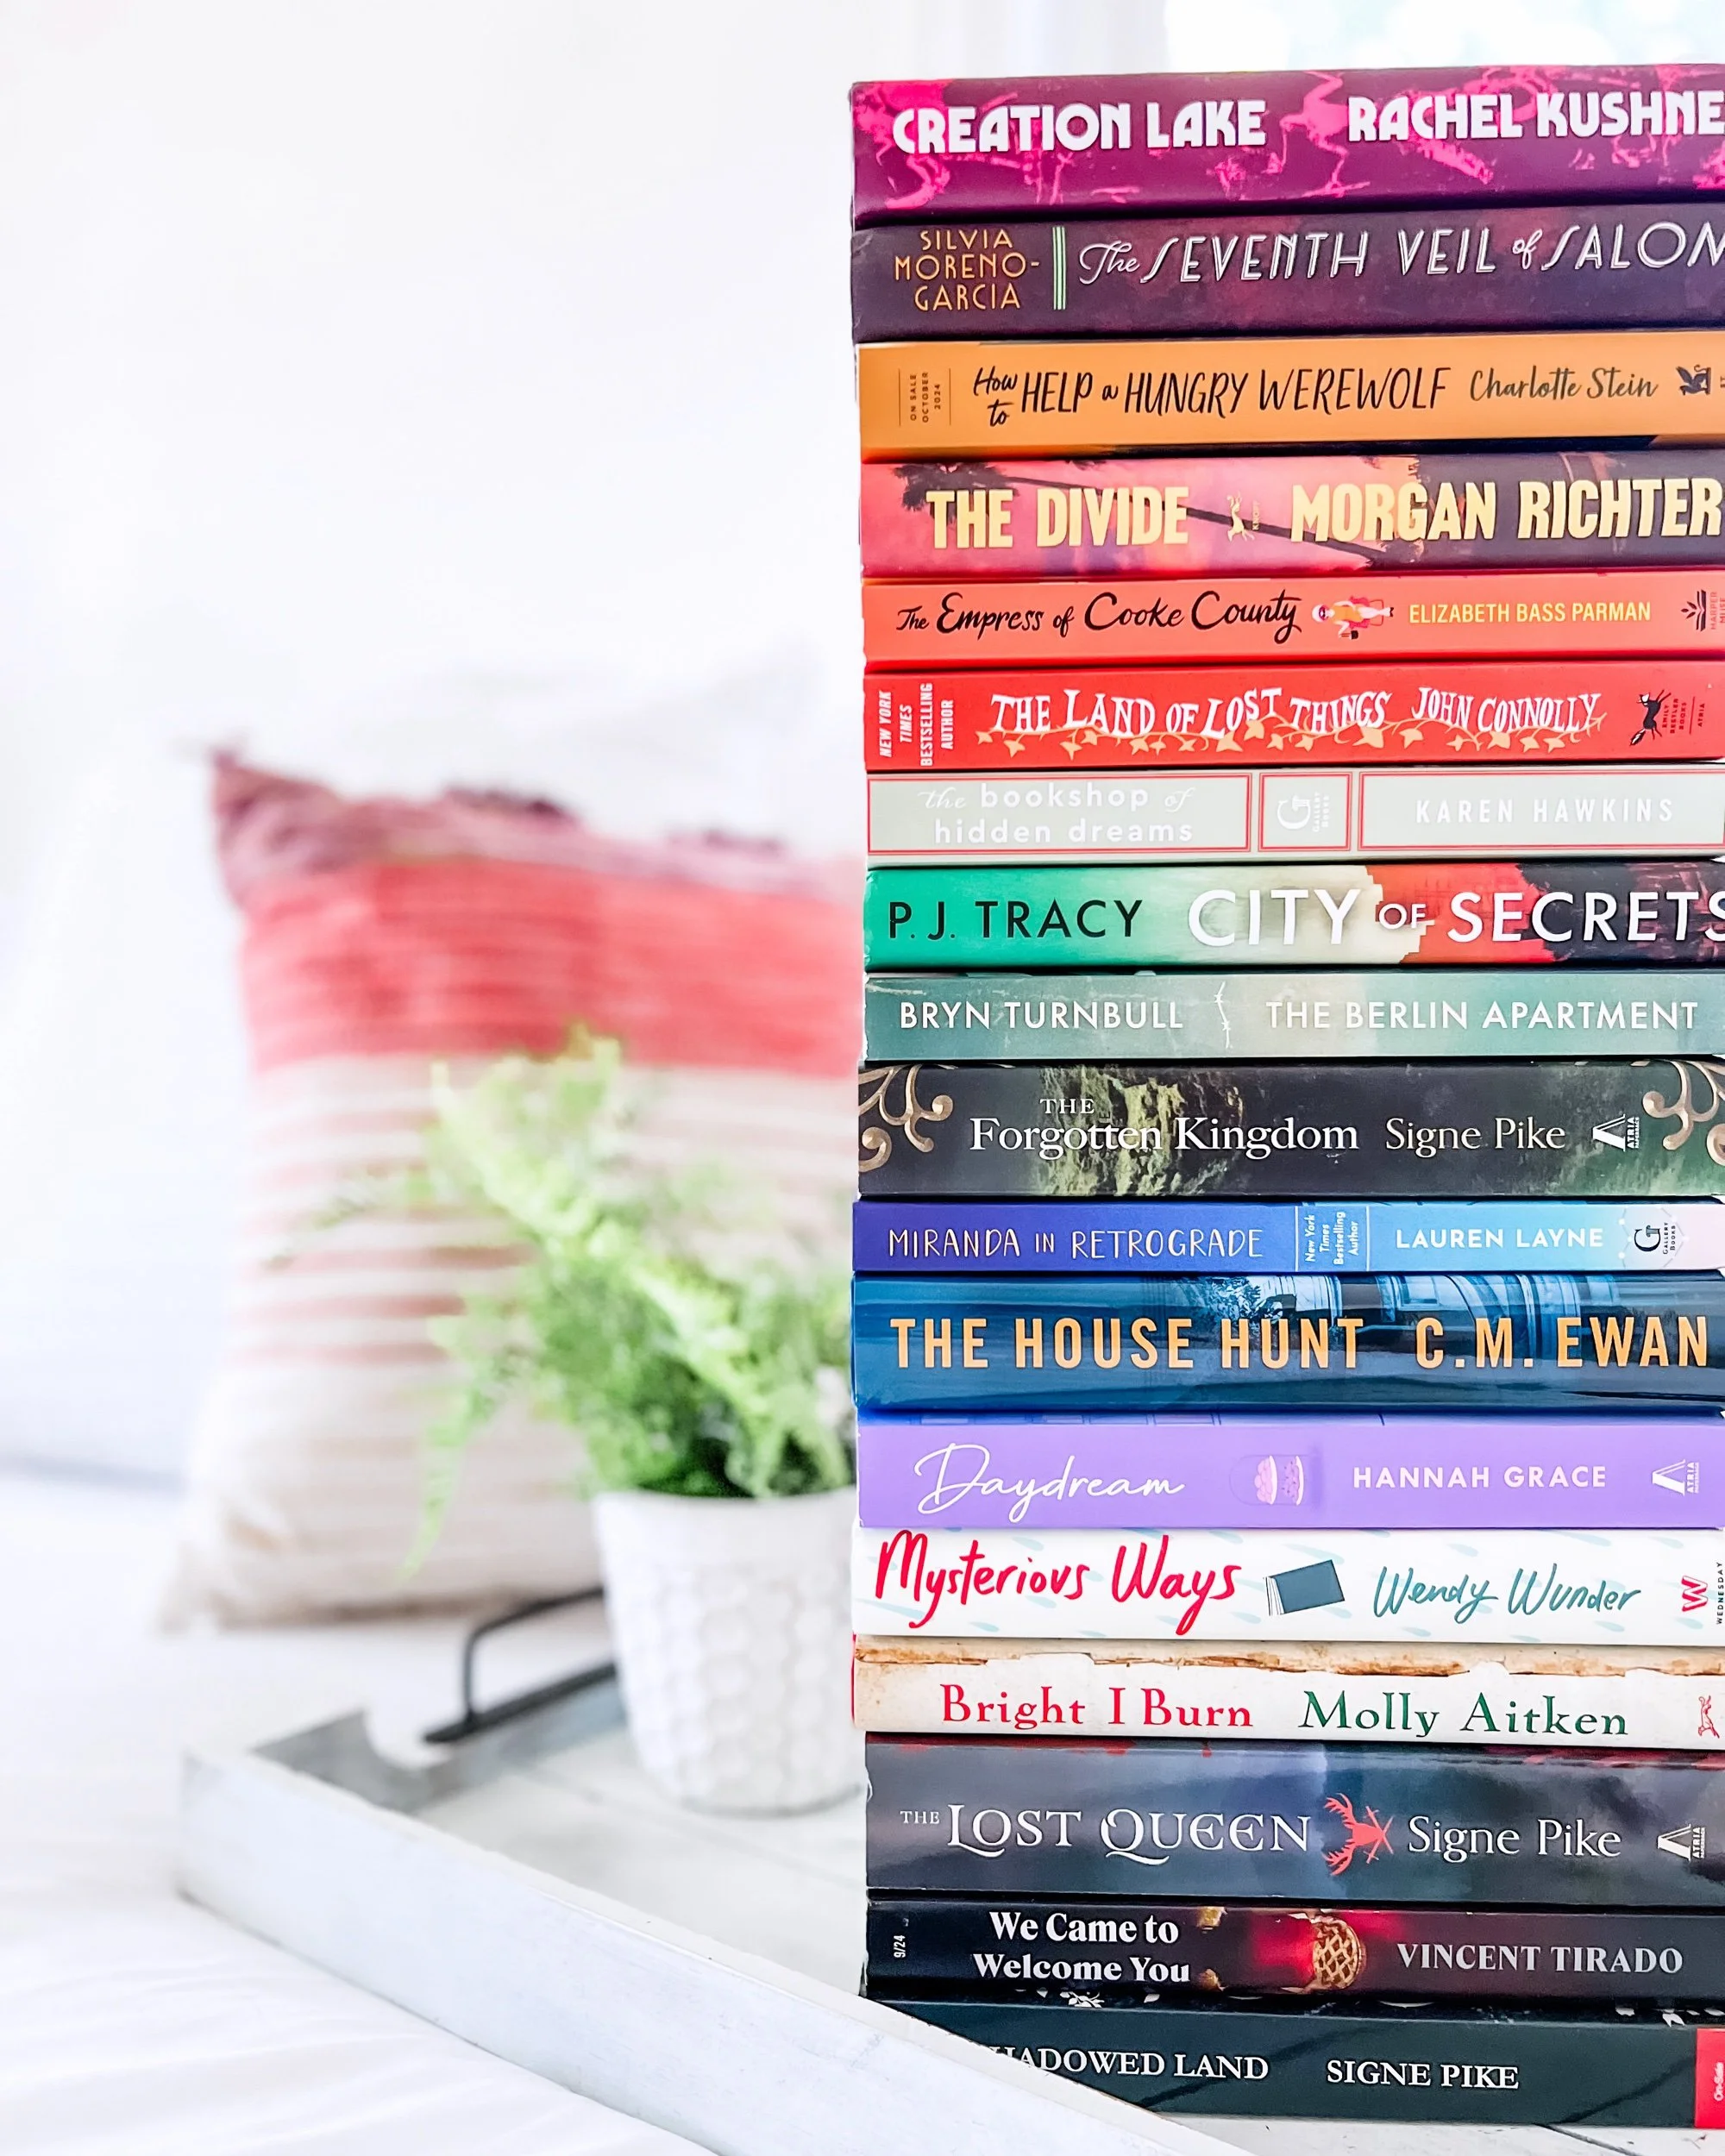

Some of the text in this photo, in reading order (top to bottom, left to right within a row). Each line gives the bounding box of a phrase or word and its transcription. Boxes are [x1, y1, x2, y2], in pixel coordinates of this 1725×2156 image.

[893, 100, 1266, 154] CREATION LAKE
[1348, 90, 1725, 141] RACHEL KUSHNE
[919, 229, 1013, 251] SILVIA
[1079, 240, 1140, 285] The
[1139, 229, 1370, 284] SEVENTH
[1397, 226, 1496, 276] VEIL
[1512, 229, 1544, 270] of
[894, 252, 1040, 280] MORENO-
[914, 283, 1021, 311] GARCIA
[974, 367, 1018, 398] How
[1021, 367, 1452, 419] HELP a HUNGRY WEREWOLF
[1470, 365, 1659, 402] Charlotte Stein
[909, 405, 917, 422] ON
[988, 401, 1014, 427] to
[925, 486, 1189, 549] THE DIVIDE
[1289, 478, 1723, 542] MORGAN RICHTER
[896, 589, 1302, 645] The Empress of Cooke County
[1408, 601, 1651, 624] ELIZABETH BASS PARMAN
[879, 690, 893, 758] NEW YORK
[900, 704, 913, 743] TIMES
[919, 682, 933, 767] BESTSELLING
[940, 699, 954, 750] AUTHOR
[990, 686, 1392, 739] THE LAND OF LOST THINGS
[1411, 687, 1603, 734] JOHN CONNOLLY
[917, 782, 1195, 817] the bookshop of
[1415, 798, 1673, 824] KAREN HAWKINS
[934, 818, 1194, 845] hidden dreams
[975, 899, 1143, 939] TRACY
[1188, 888, 1725, 947] CITY OF SECRETS
[900, 1000, 1183, 1030] BRYN TURNBULL
[1265, 1000, 1698, 1030] THE BERLIN APARTMENT
[1039, 1098, 1095, 1115] THE
[969, 1116, 1359, 1162] Forgotten Kingdom
[1385, 1116, 1566, 1158] Signe Pike
[888, 1227, 1264, 1259] MIRANDA IN RETROGRADE
[1303, 1214, 1316, 1263] New York
[1319, 1224, 1330, 1253] Times
[1333, 1212, 1346, 1265] Bestselling
[1347, 1221, 1359, 1257] Author
[1396, 1227, 1603, 1249] LAUREN LAYNE
[890, 1317, 1364, 1369] THE HOUSE HUNT
[1415, 1315, 1708, 1369] C.M. EWAN
[913, 1443, 1186, 1524] Daydream
[1352, 1465, 1607, 1489] HANNAH GRACE
[875, 1529, 1242, 1636] Mysterious Ways
[1372, 1563, 1641, 1624] Wendy Wunder
[1716, 1562, 1724, 1625] WEDNESDAY
[940, 1683, 1253, 1731] Bright I Burn
[1297, 1689, 1629, 1739] Molly Aitken
[900, 1804, 1312, 1865] THE LOST QUEEN
[1408, 1815, 1622, 1863] Signe Pike
[894, 1934, 906, 1959] 9/24
[988, 1911, 1180, 1945] We Came to
[973, 1953, 1191, 1984] Welcome You
[1396, 1943, 1684, 1975] VINCENT TIRADO
[1173, 2053, 1270, 2081] LAND
[1327, 2059, 1520, 2090] SIGNE PIKE
